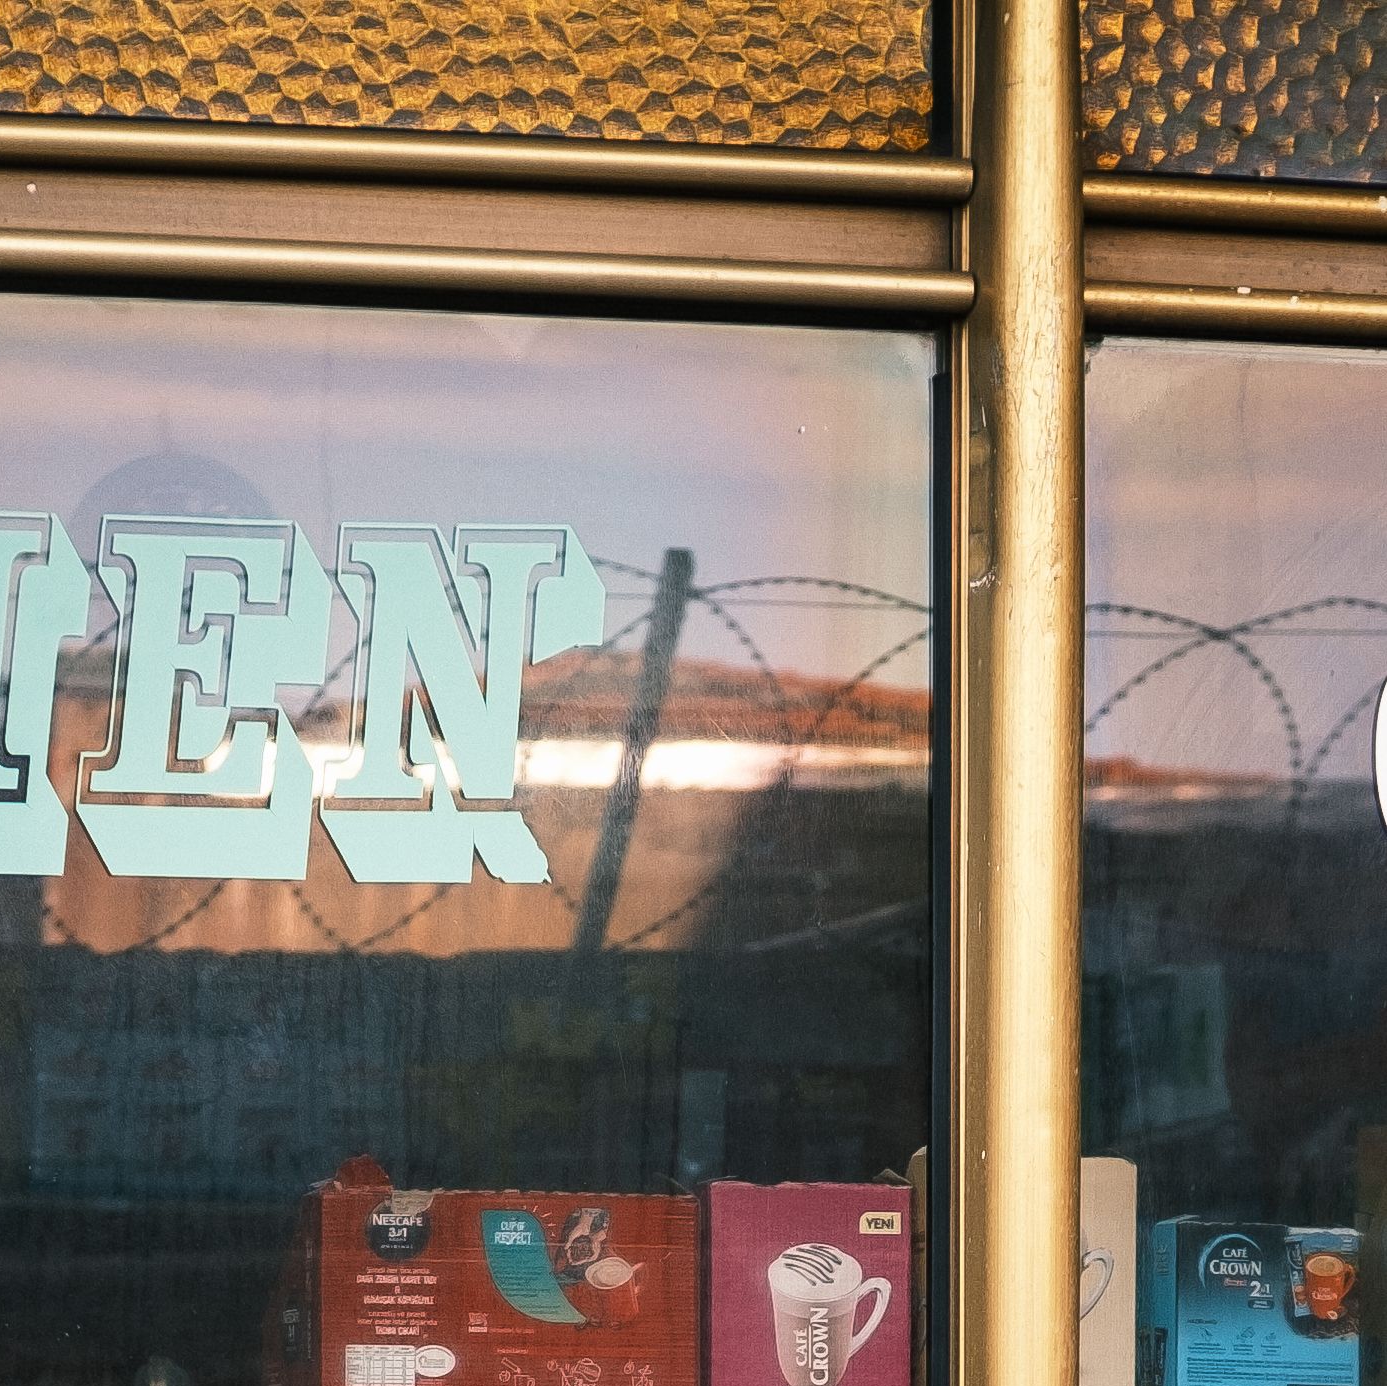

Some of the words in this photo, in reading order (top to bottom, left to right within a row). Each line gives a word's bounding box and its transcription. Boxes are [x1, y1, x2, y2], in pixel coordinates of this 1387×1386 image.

[865, 1216, 895, 1231] YENİ
[494, 1232, 532, 1245] RESPECT
[1222, 1247, 1249, 1258] CAFÉ
[1209, 1259, 1262, 1277] CROWN
[809, 1306, 830, 1386] CROWN
